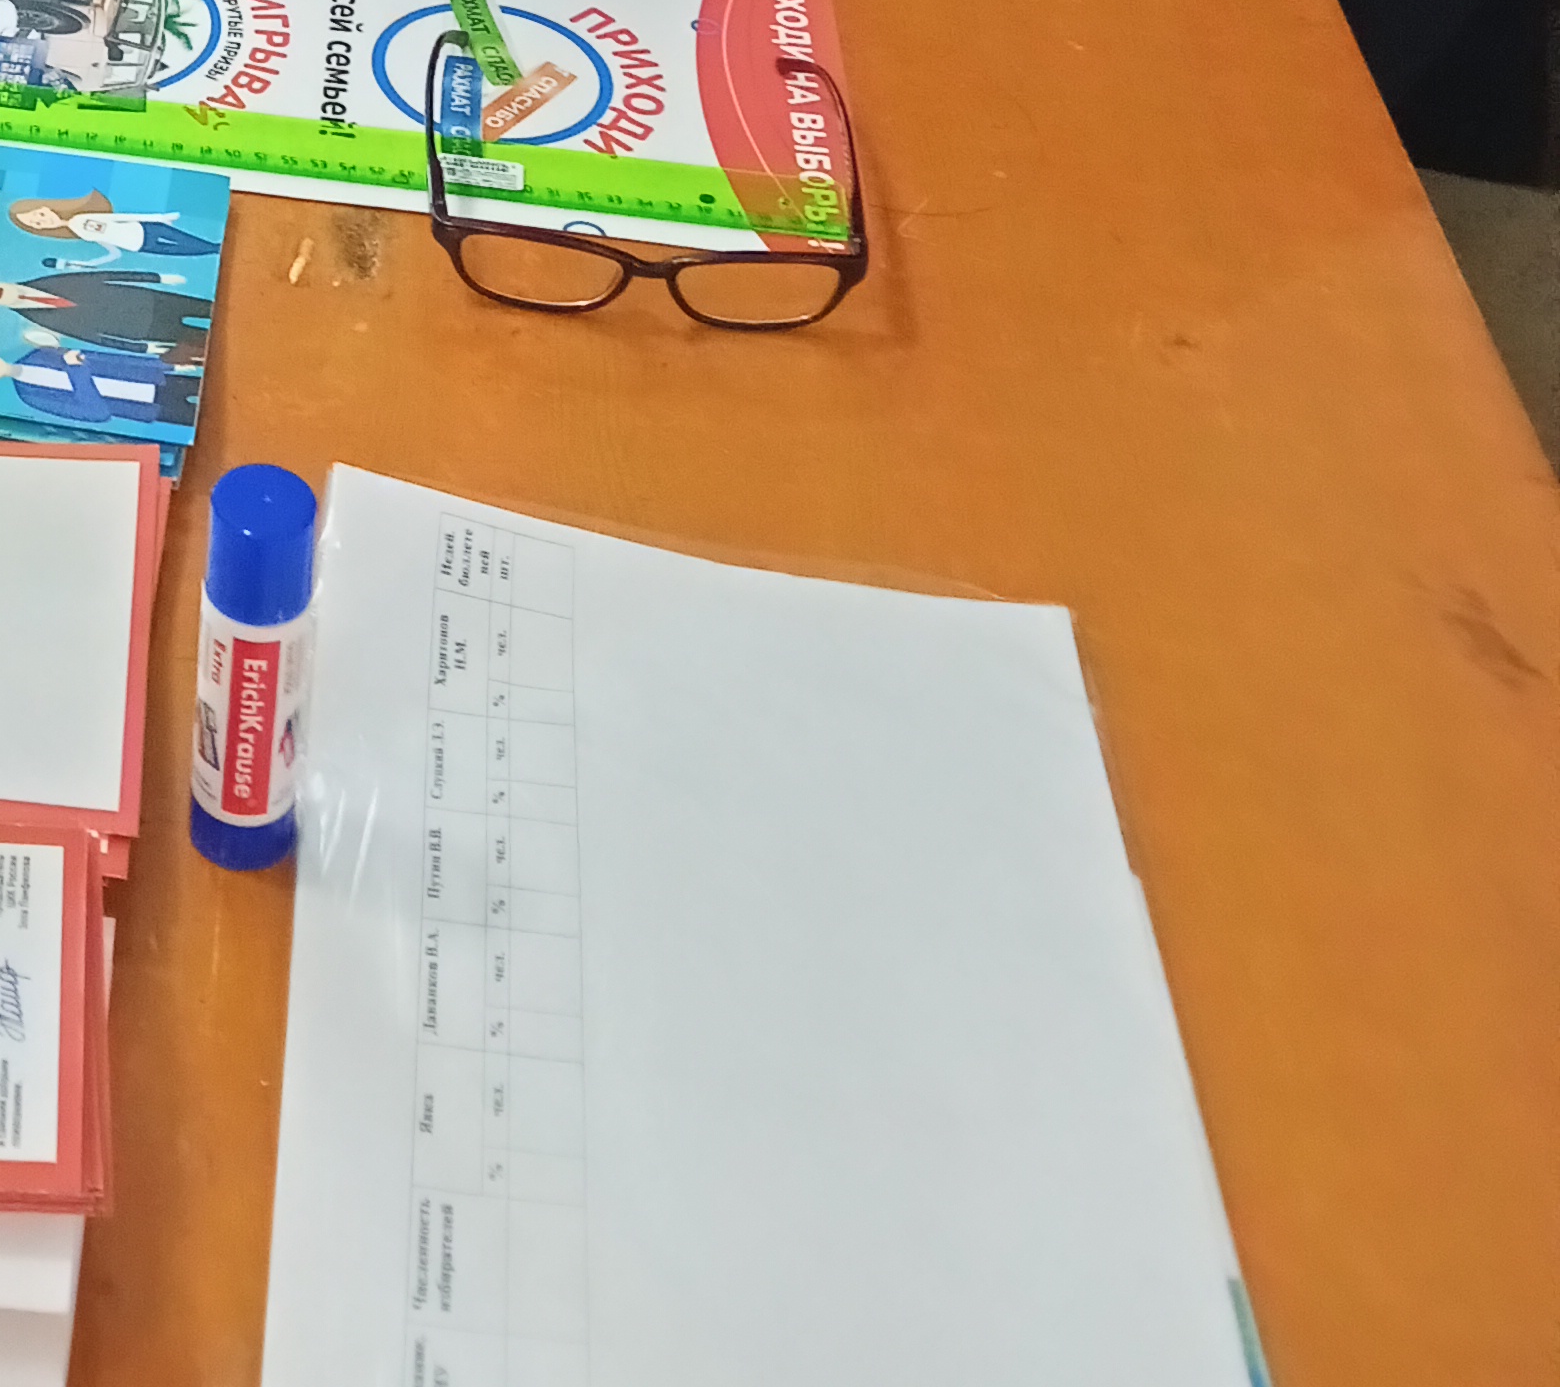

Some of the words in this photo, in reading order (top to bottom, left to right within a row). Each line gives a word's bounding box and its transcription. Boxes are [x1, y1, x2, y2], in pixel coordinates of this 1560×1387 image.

[207, 39, 242, 84] ПРИЗЫ
[320, 39, 355, 140] семьей!
[448, 62, 472, 116] РАХМАТ
[571, 5, 666, 163] ПРИХОДИ
[784, 69, 820, 106] НА
[484, 74, 556, 130] СПАСИБО
[212, 638, 228, 686] Extra
[433, 614, 450, 685] Харитонов
[233, 657, 268, 801] ErichKrause
